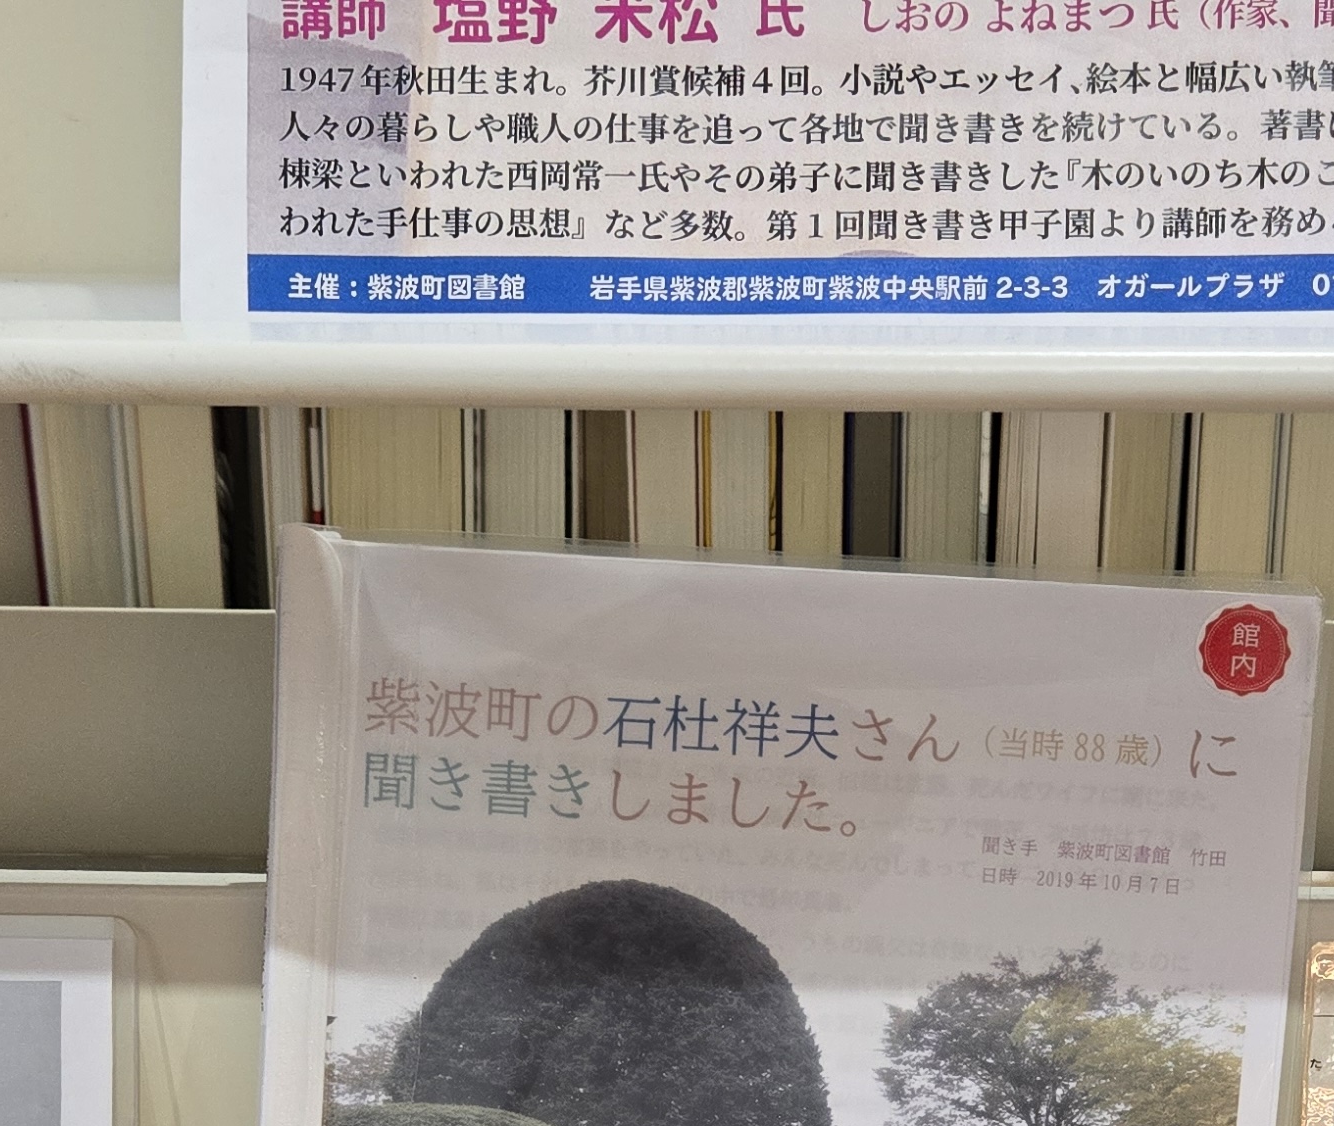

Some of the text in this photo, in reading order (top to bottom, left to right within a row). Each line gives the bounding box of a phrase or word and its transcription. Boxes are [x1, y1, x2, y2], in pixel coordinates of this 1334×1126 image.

[282, 0, 387, 41] 講師
[432, 0, 557, 44] 塩野
[996, 277, 1069, 299] 2-3-3
[1097, 271, 1285, 299] オガールプラザ
[364, 751, 858, 838] 聞き書きしました。
[981, 836, 1227, 867] 聞き手 紫波町図書館 竹田
[981, 867, 1018, 886] 日時
